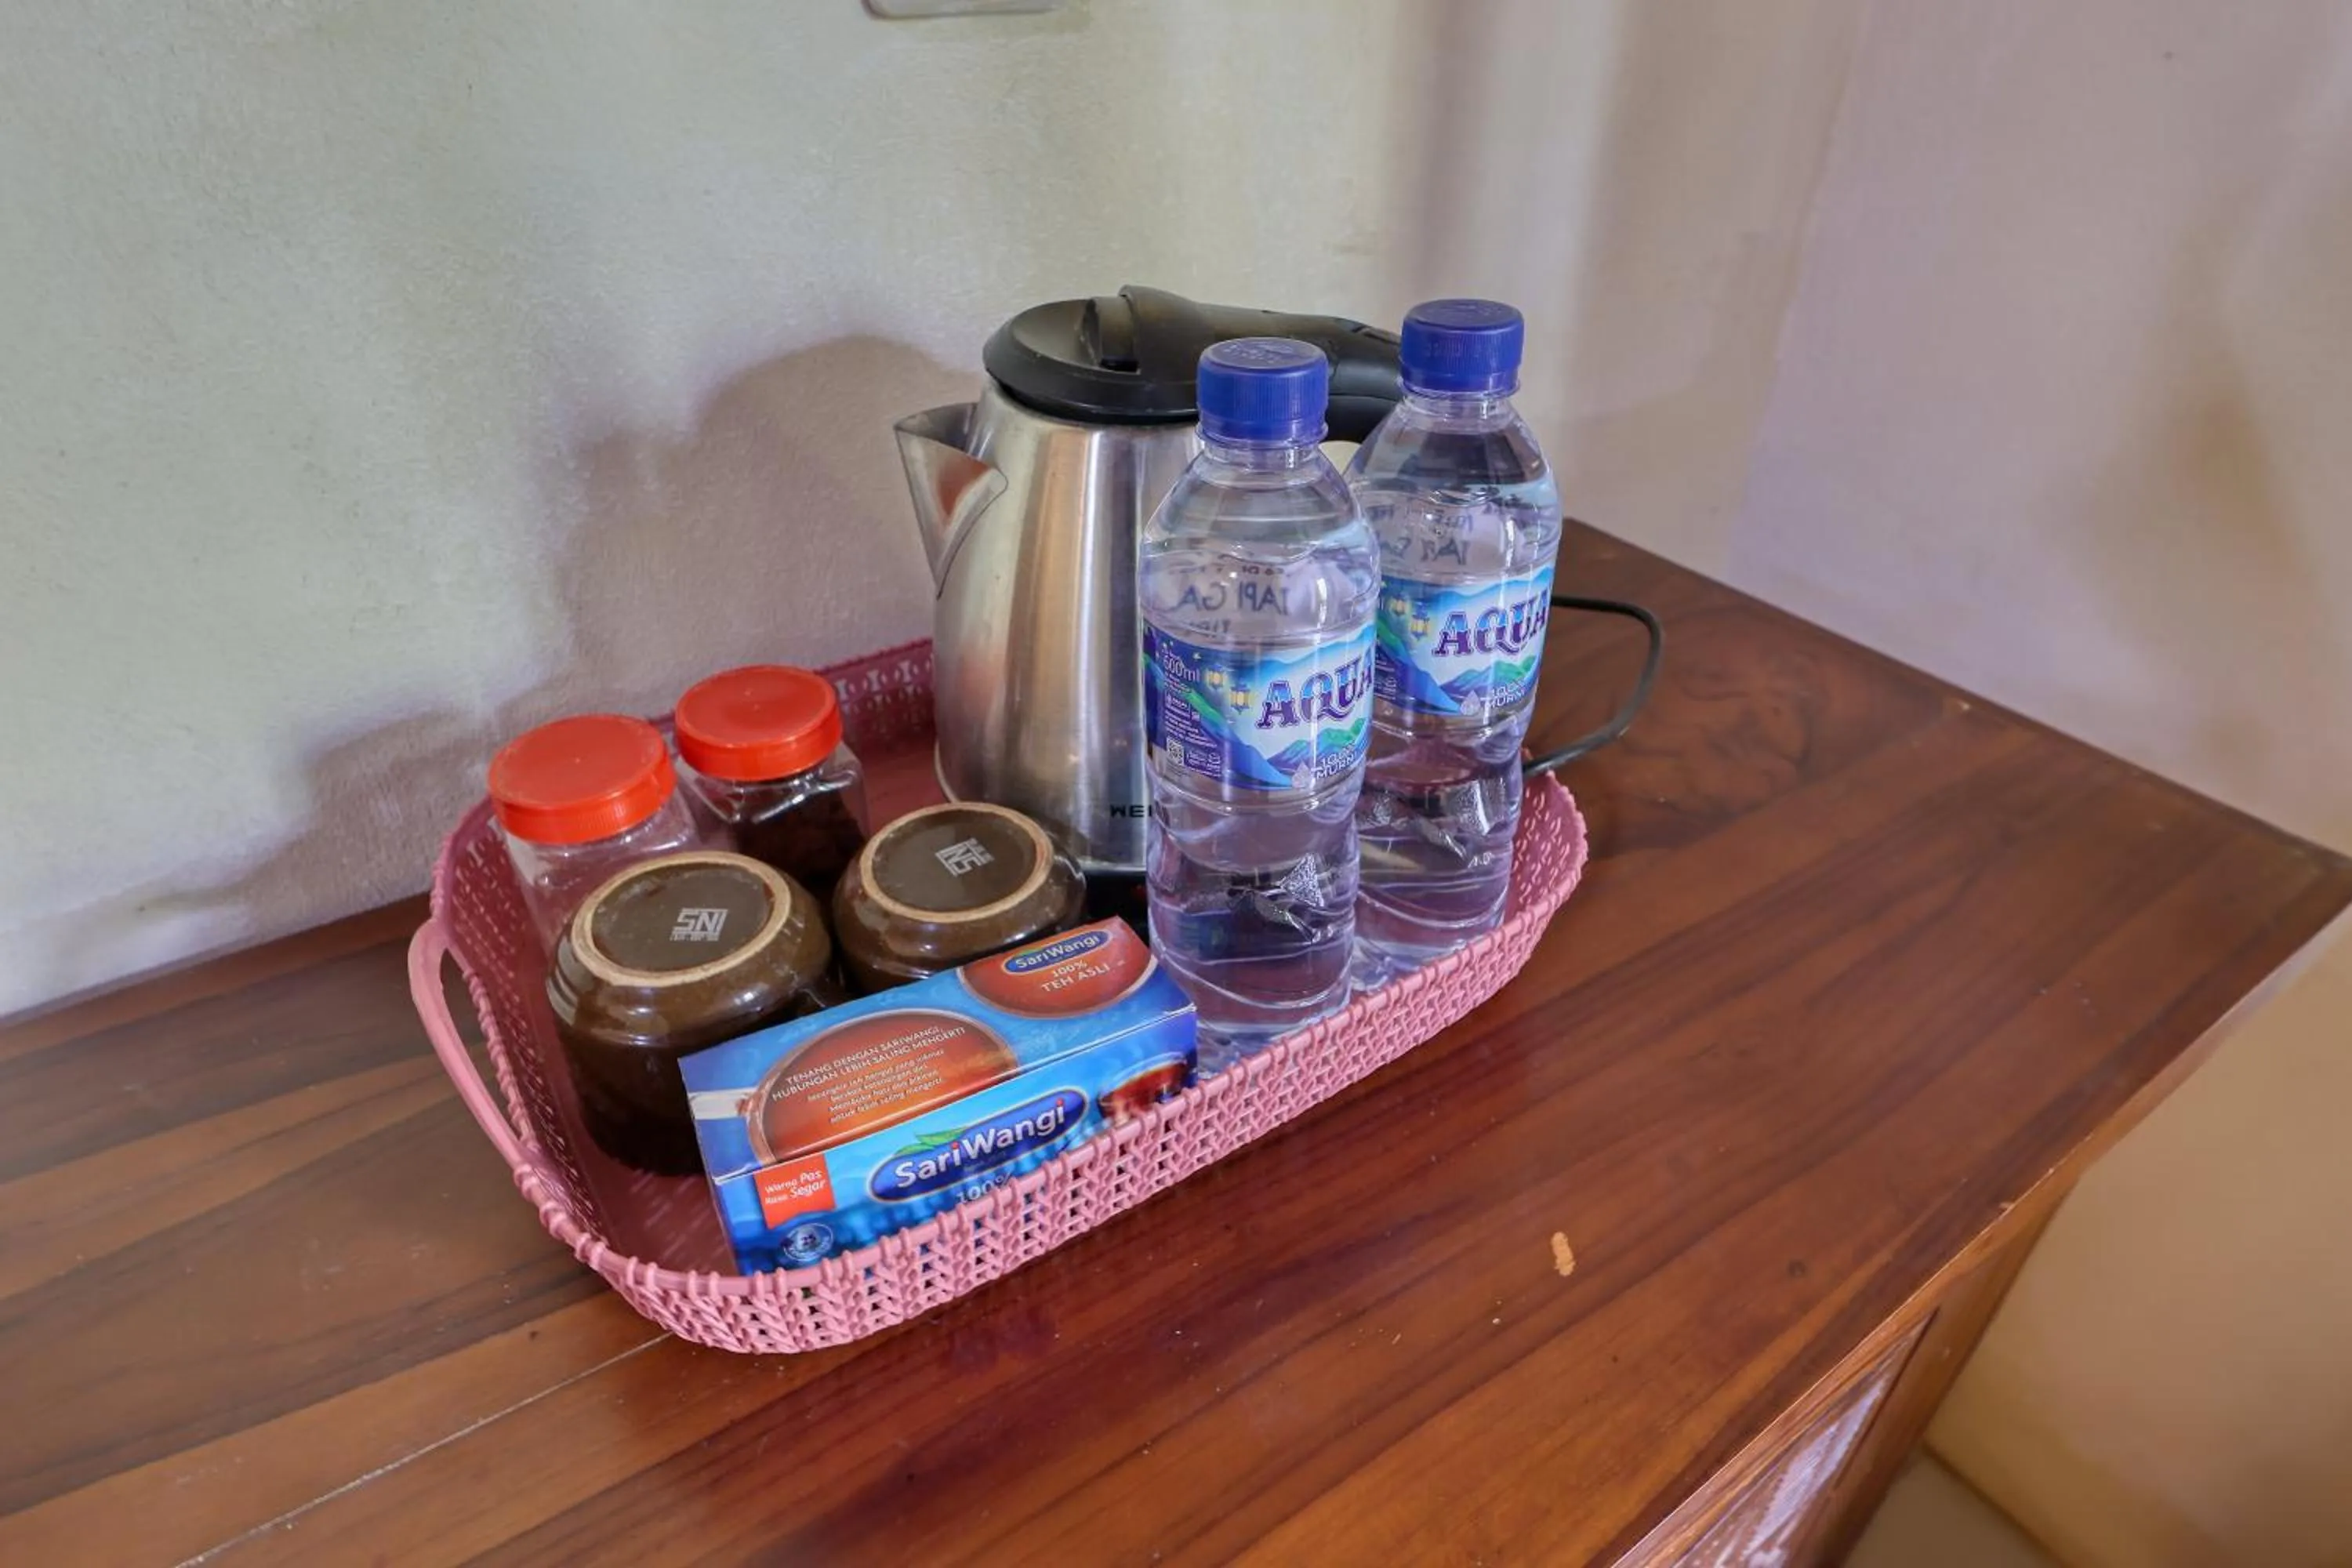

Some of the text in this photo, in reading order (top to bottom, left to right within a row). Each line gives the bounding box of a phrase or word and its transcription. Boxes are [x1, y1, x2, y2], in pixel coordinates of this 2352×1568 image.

[1432, 588, 1548, 657] AQUA
[1254, 645, 1374, 729] AQUA
[672, 908, 728, 934] SNI
[1014, 935, 1101, 969] SariWangi
[1040, 962, 1111, 993] TEH ASLI
[1052, 959, 1088, 978] 100%
[786, 1063, 832, 1084] TENANG
[833, 1047, 879, 1069] DENGAN
[771, 1070, 838, 1102] HUBUNGAN
[894, 1098, 1066, 1189] SariWangi
[789, 1178, 826, 1198] Segar
[799, 1168, 823, 1183] Pas
